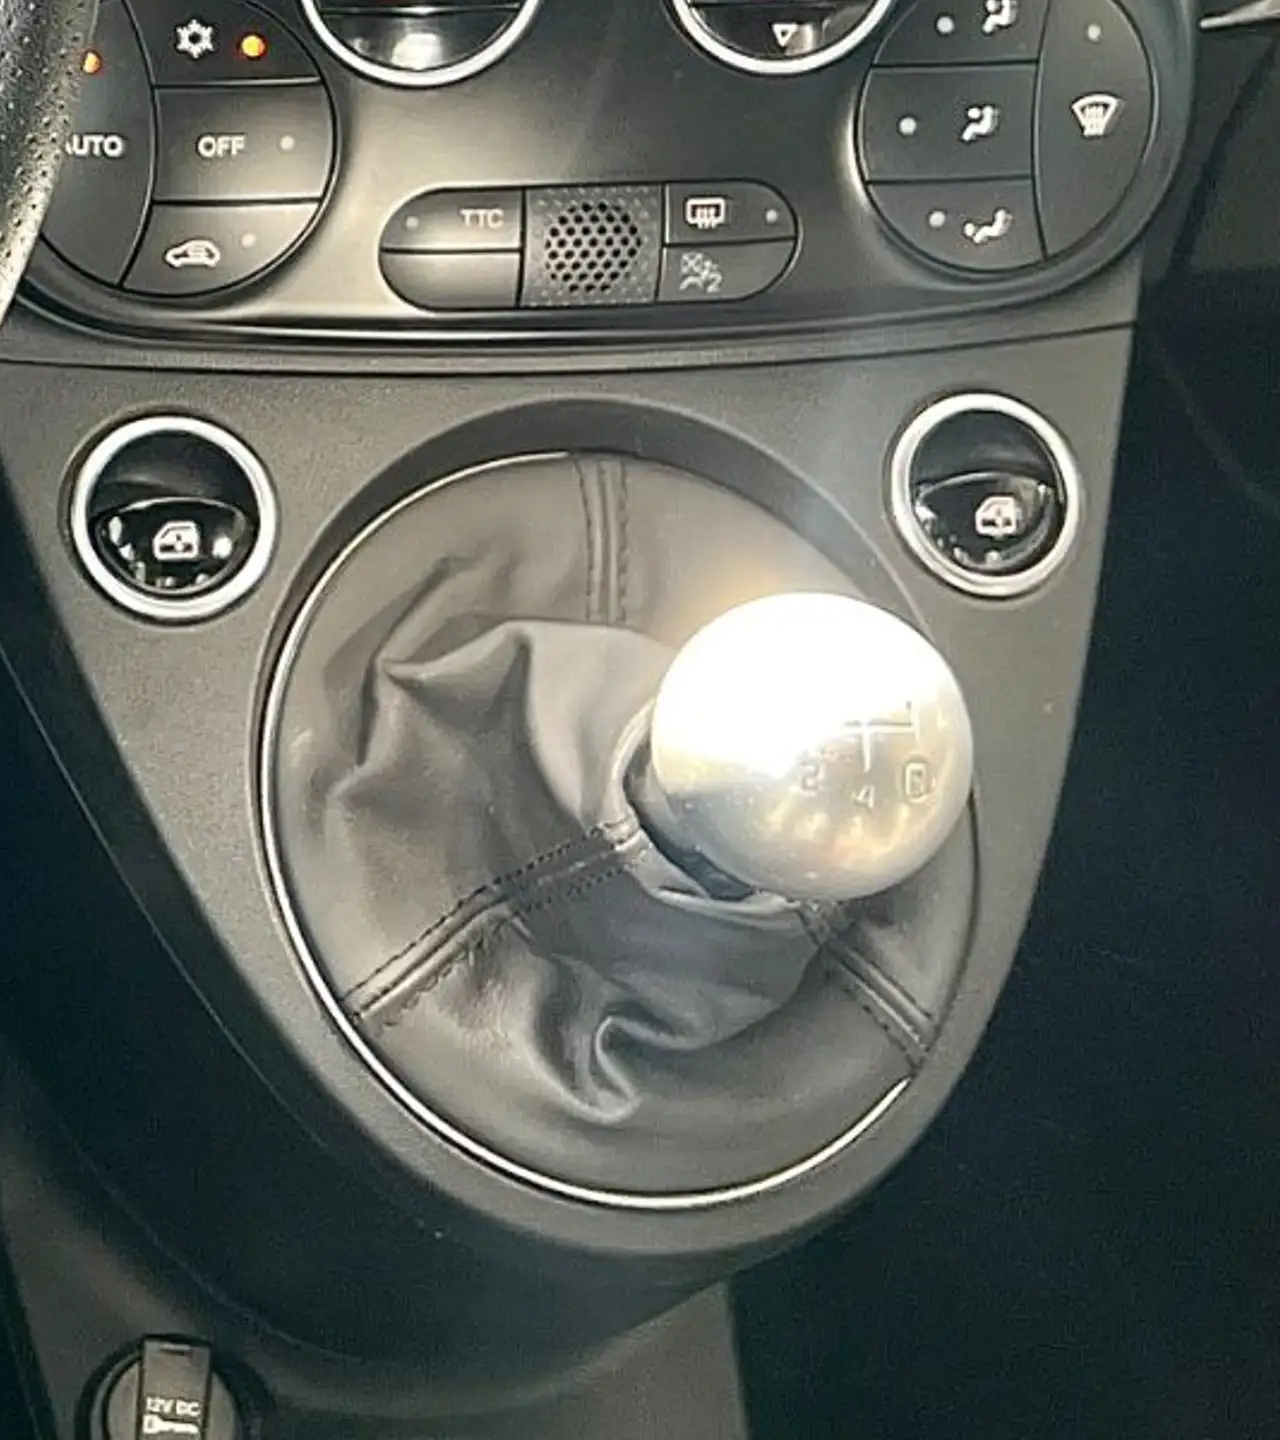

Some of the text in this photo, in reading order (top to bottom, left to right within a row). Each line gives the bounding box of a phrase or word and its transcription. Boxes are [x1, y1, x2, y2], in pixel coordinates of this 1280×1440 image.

[197, 134, 245, 156] OFF
[460, 208, 504, 229] TTC
[146, 1396, 202, 1417] 12V DC
